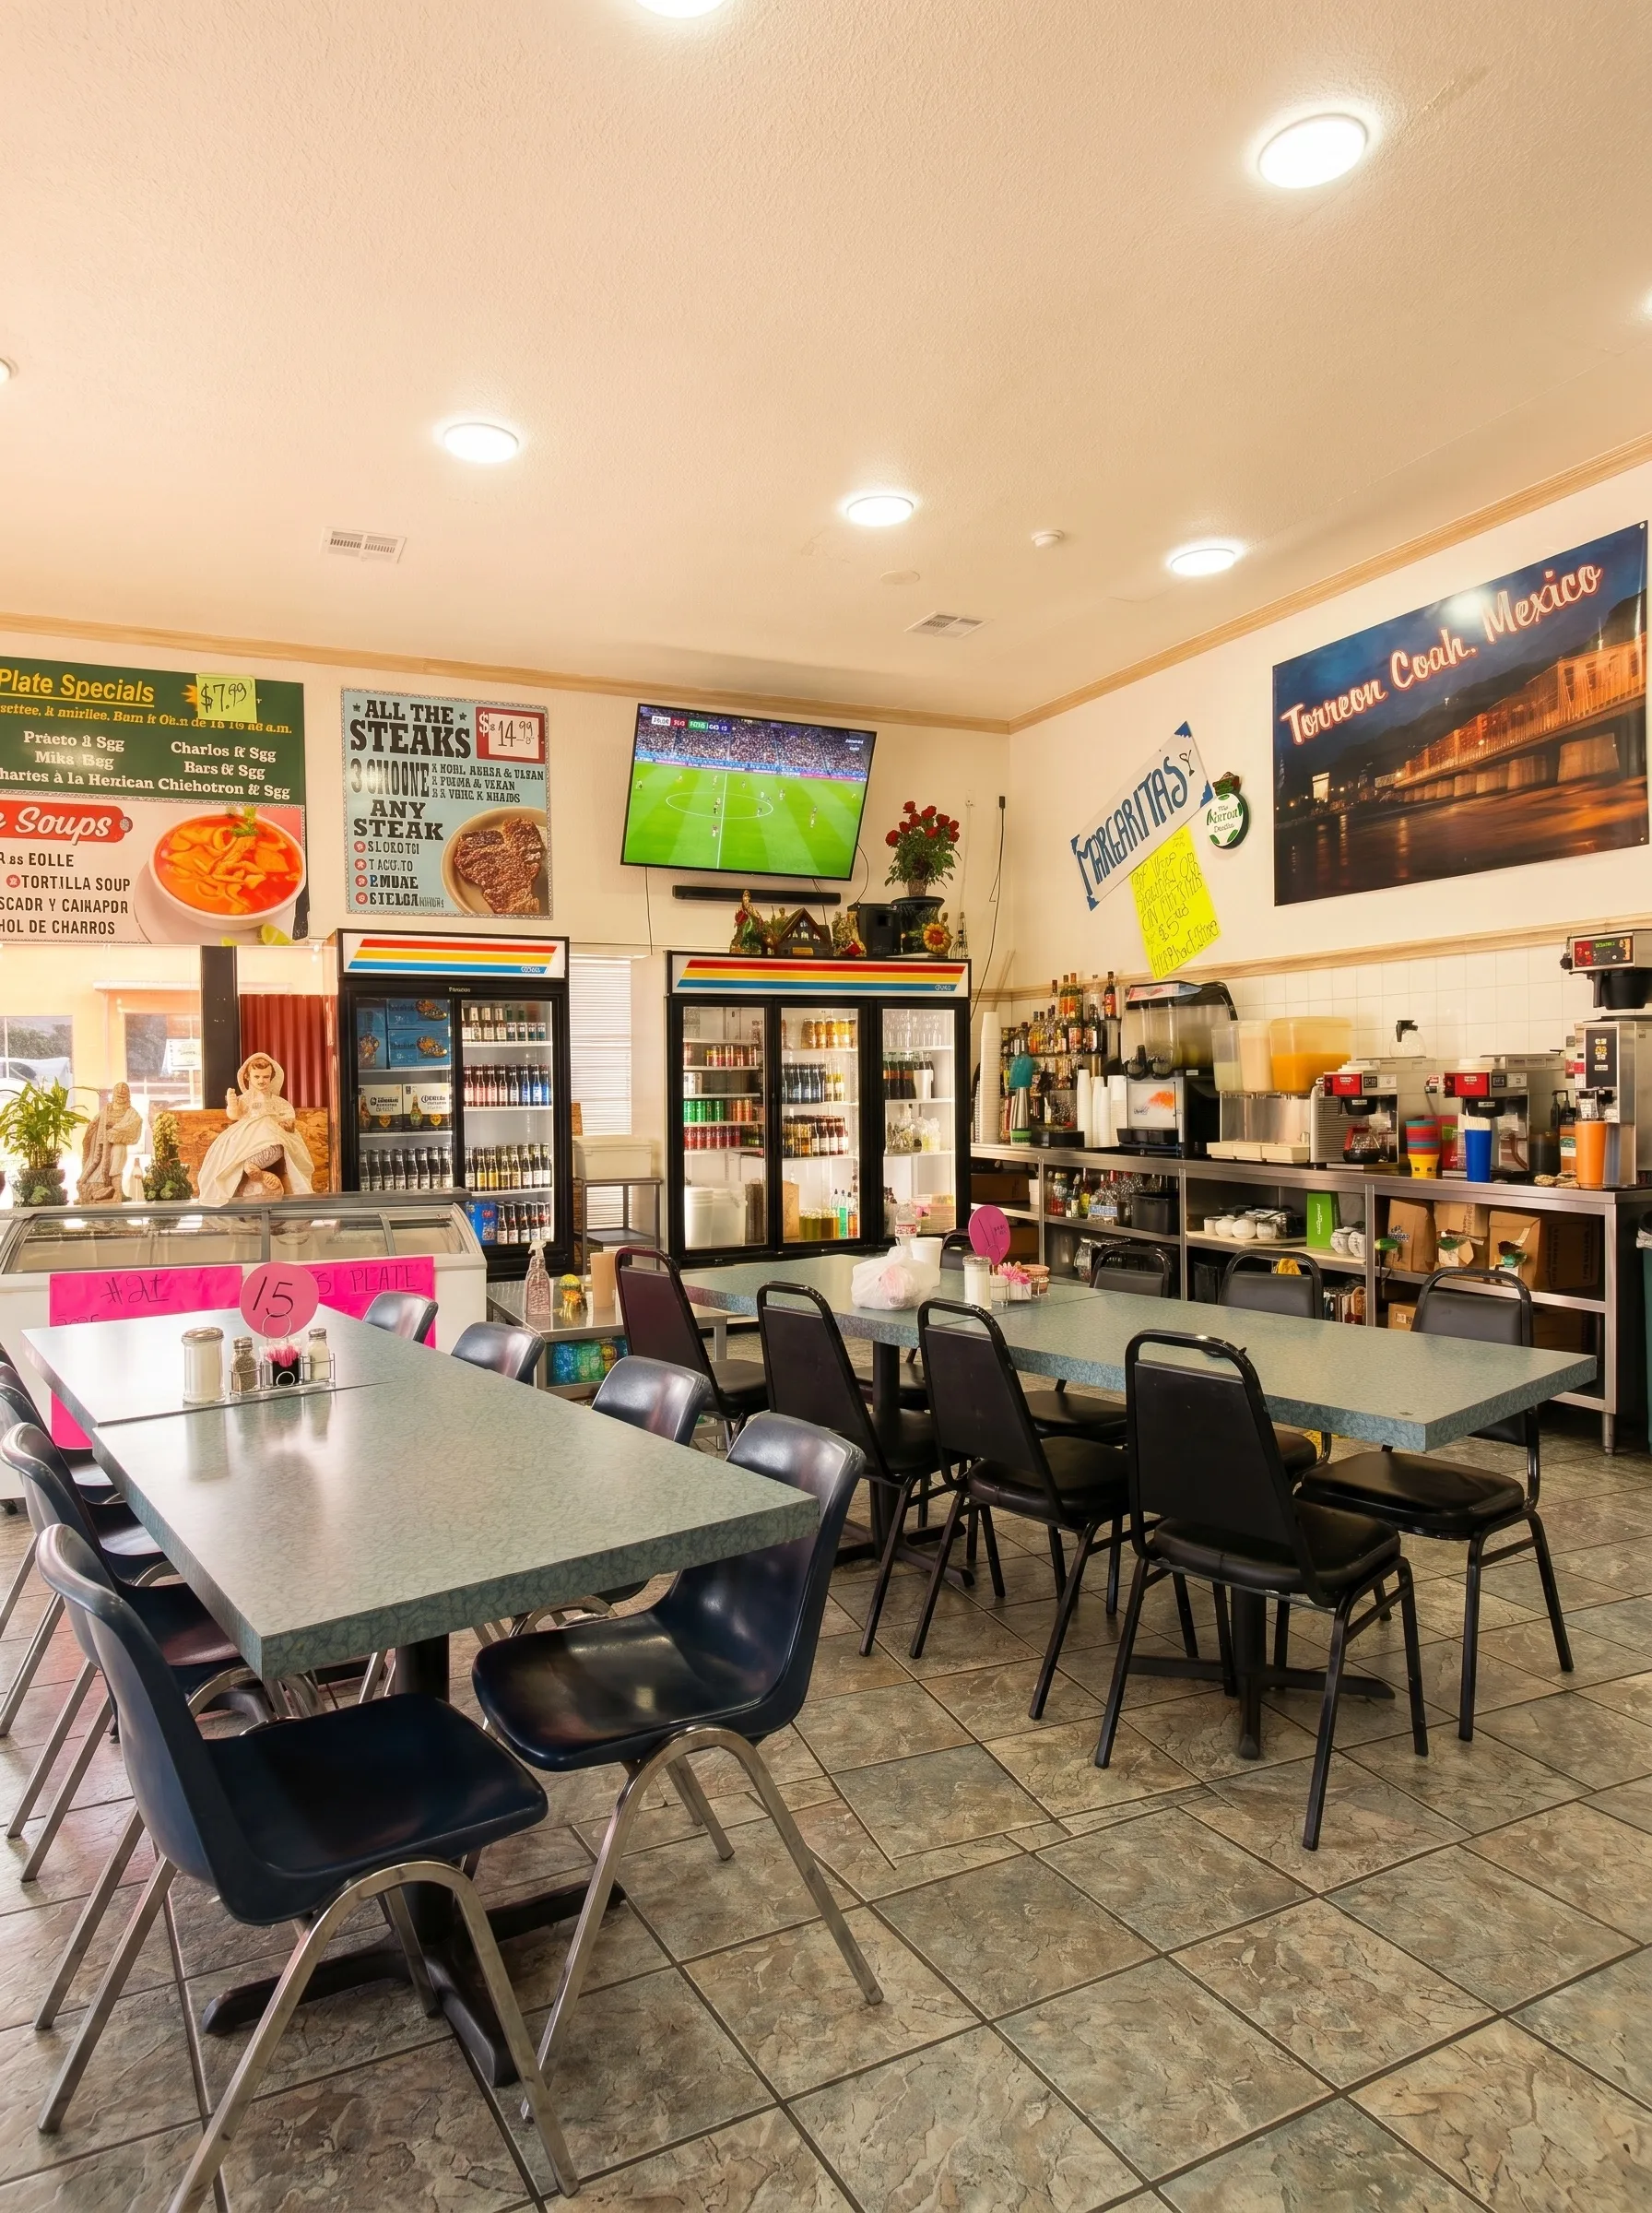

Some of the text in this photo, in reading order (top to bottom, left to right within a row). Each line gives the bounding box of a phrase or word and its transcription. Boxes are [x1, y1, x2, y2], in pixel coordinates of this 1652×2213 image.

[1280, 564, 1602, 744] Torreon Coah. Mexico
[0, 669, 155, 702] Plate Specials
[365, 700, 454, 725] ALL THE
[350, 719, 471, 759] STEAKS
[371, 799, 426, 819] ANY
[15, 806, 112, 846] Soups
[354, 818, 443, 841] STEAK
[21, 875, 130, 892] TORTILLA SOUP
[49, 898, 55, 911] Y
[29, 919, 46, 933] DE
[52, 920, 115, 934] CHARROS
[350, 1265, 416, 1292] PLATE
